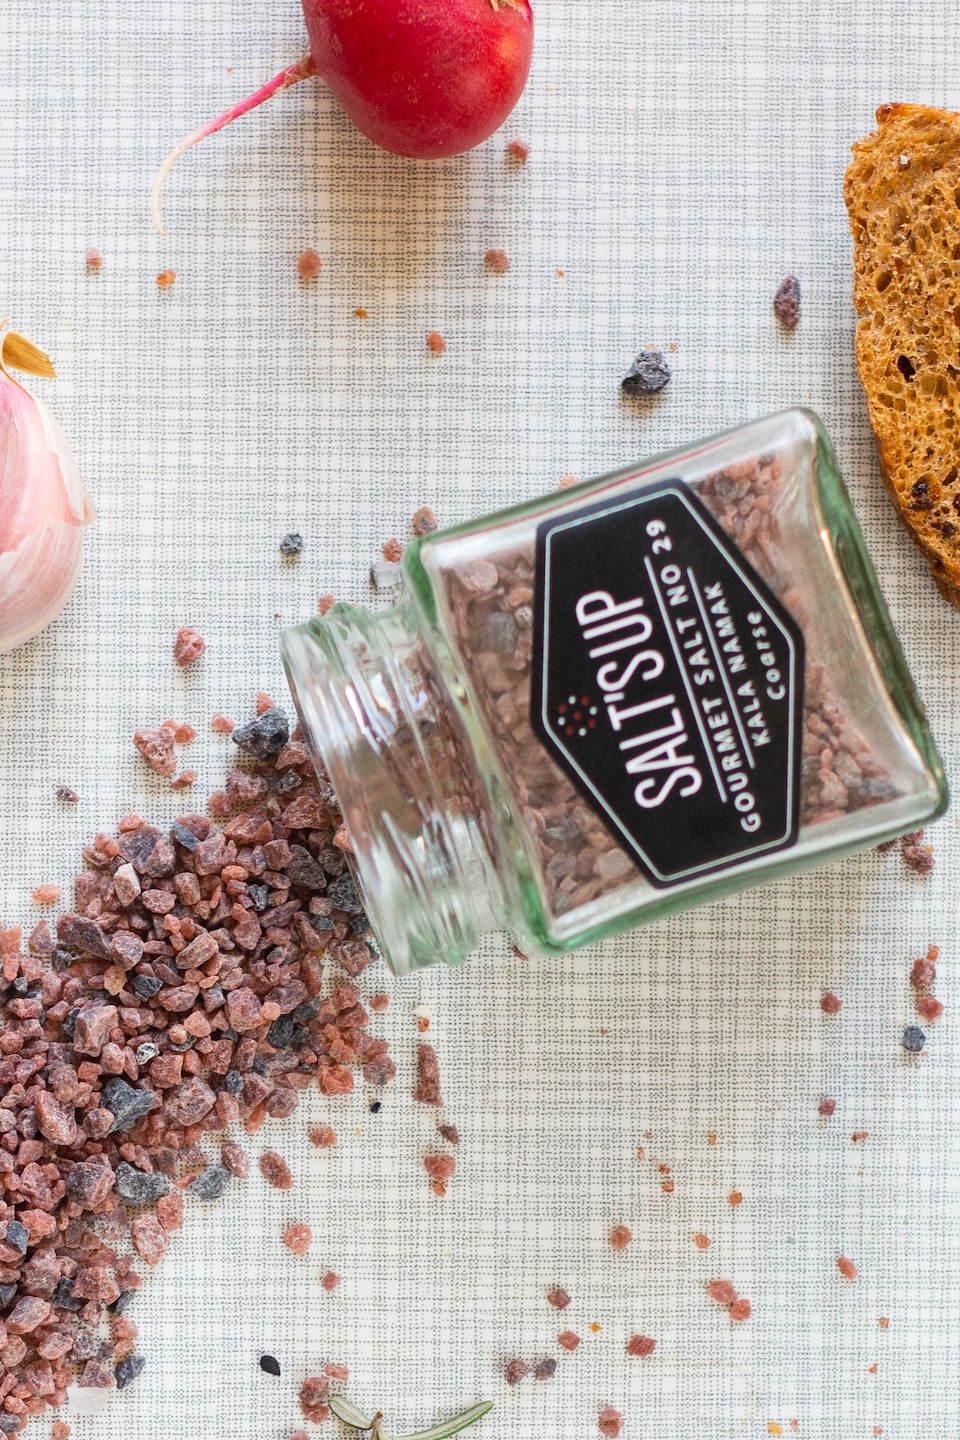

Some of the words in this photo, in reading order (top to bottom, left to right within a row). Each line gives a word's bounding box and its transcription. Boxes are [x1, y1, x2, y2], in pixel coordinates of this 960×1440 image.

[645, 518, 673, 555] 29
[660, 563, 691, 606] NO
[676, 617, 715, 687] SALT
[704, 580, 747, 675] NAMAK
[746, 610, 786, 700] Coarse
[737, 679, 771, 746] KALA
[701, 696, 762, 833] GOURMET
